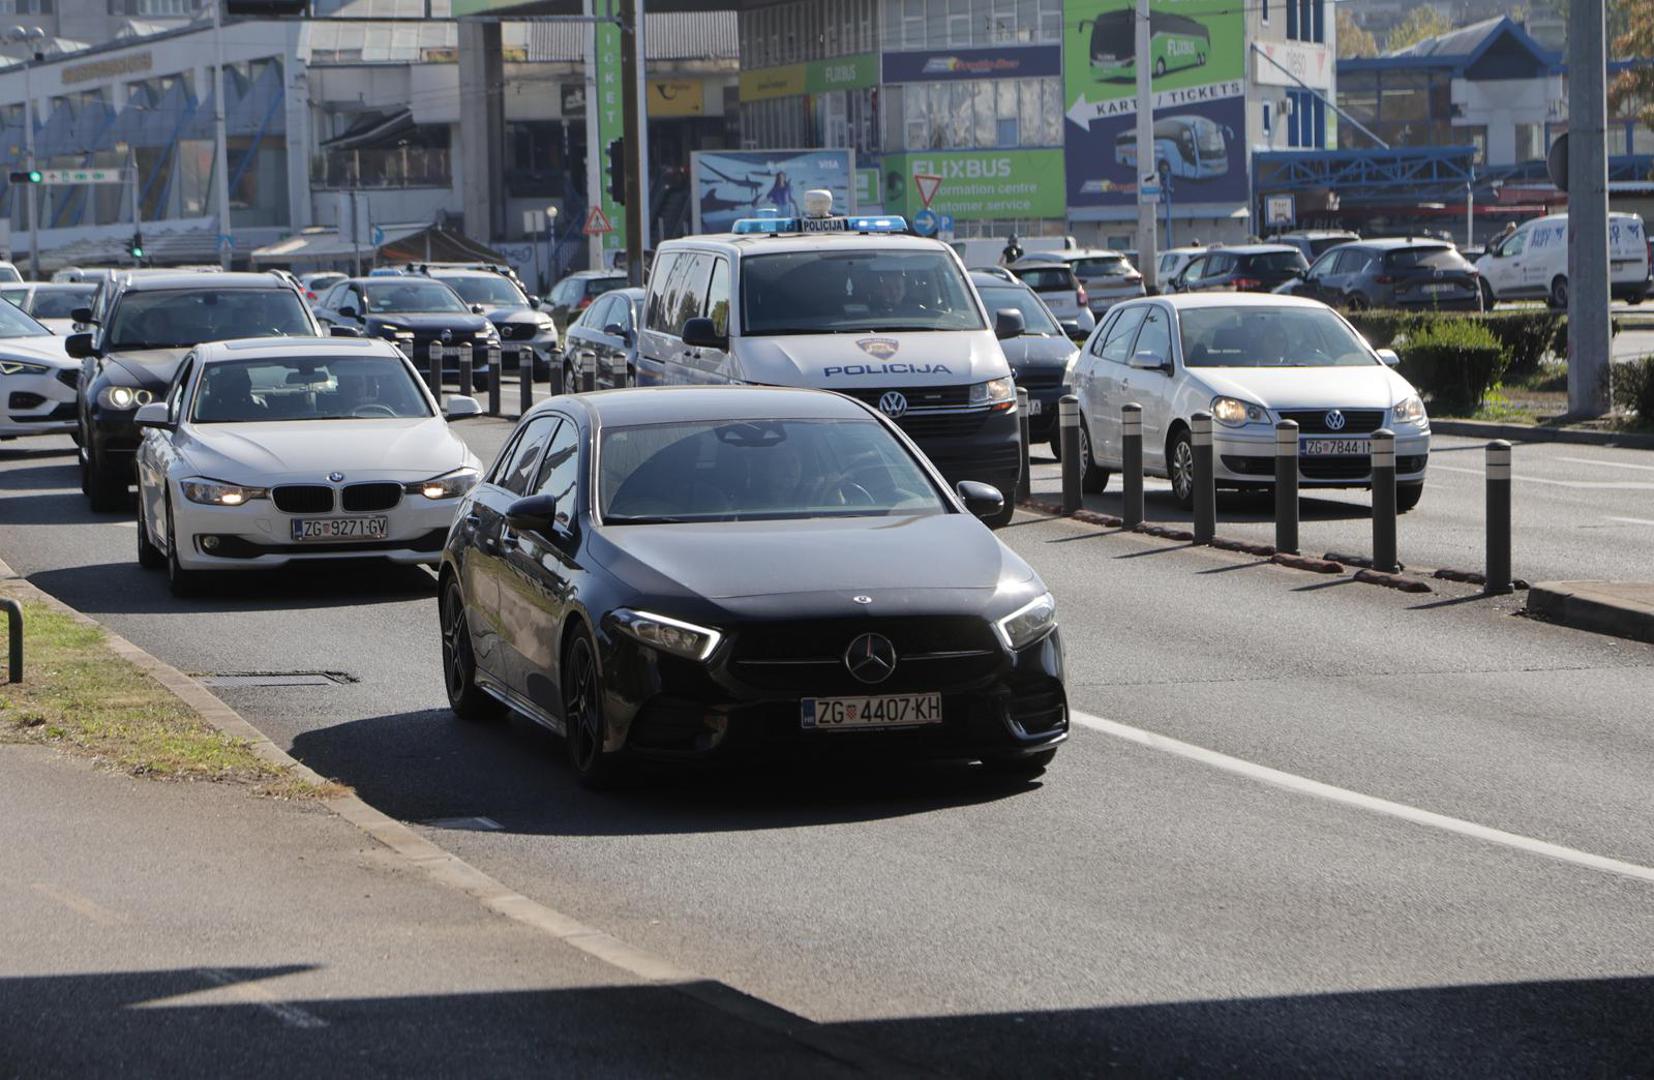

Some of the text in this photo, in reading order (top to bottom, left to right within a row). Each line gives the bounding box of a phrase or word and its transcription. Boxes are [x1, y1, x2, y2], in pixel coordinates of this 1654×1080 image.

[604, 33, 614, 124] ICKET
[1096, 99, 1137, 116] KART
[1170, 82, 1240, 104] TICKETS
[818, 160, 840, 169] VISA
[937, 183, 1037, 197] ormation centre
[934, 200, 1031, 213] ustomer service
[803, 219, 842, 232] POLICIJA
[823, 363, 952, 377] POLICIJA
[1308, 440, 1322, 454] ZG
[304, 521, 321, 537] ZG
[818, 701, 845, 724] ZG
